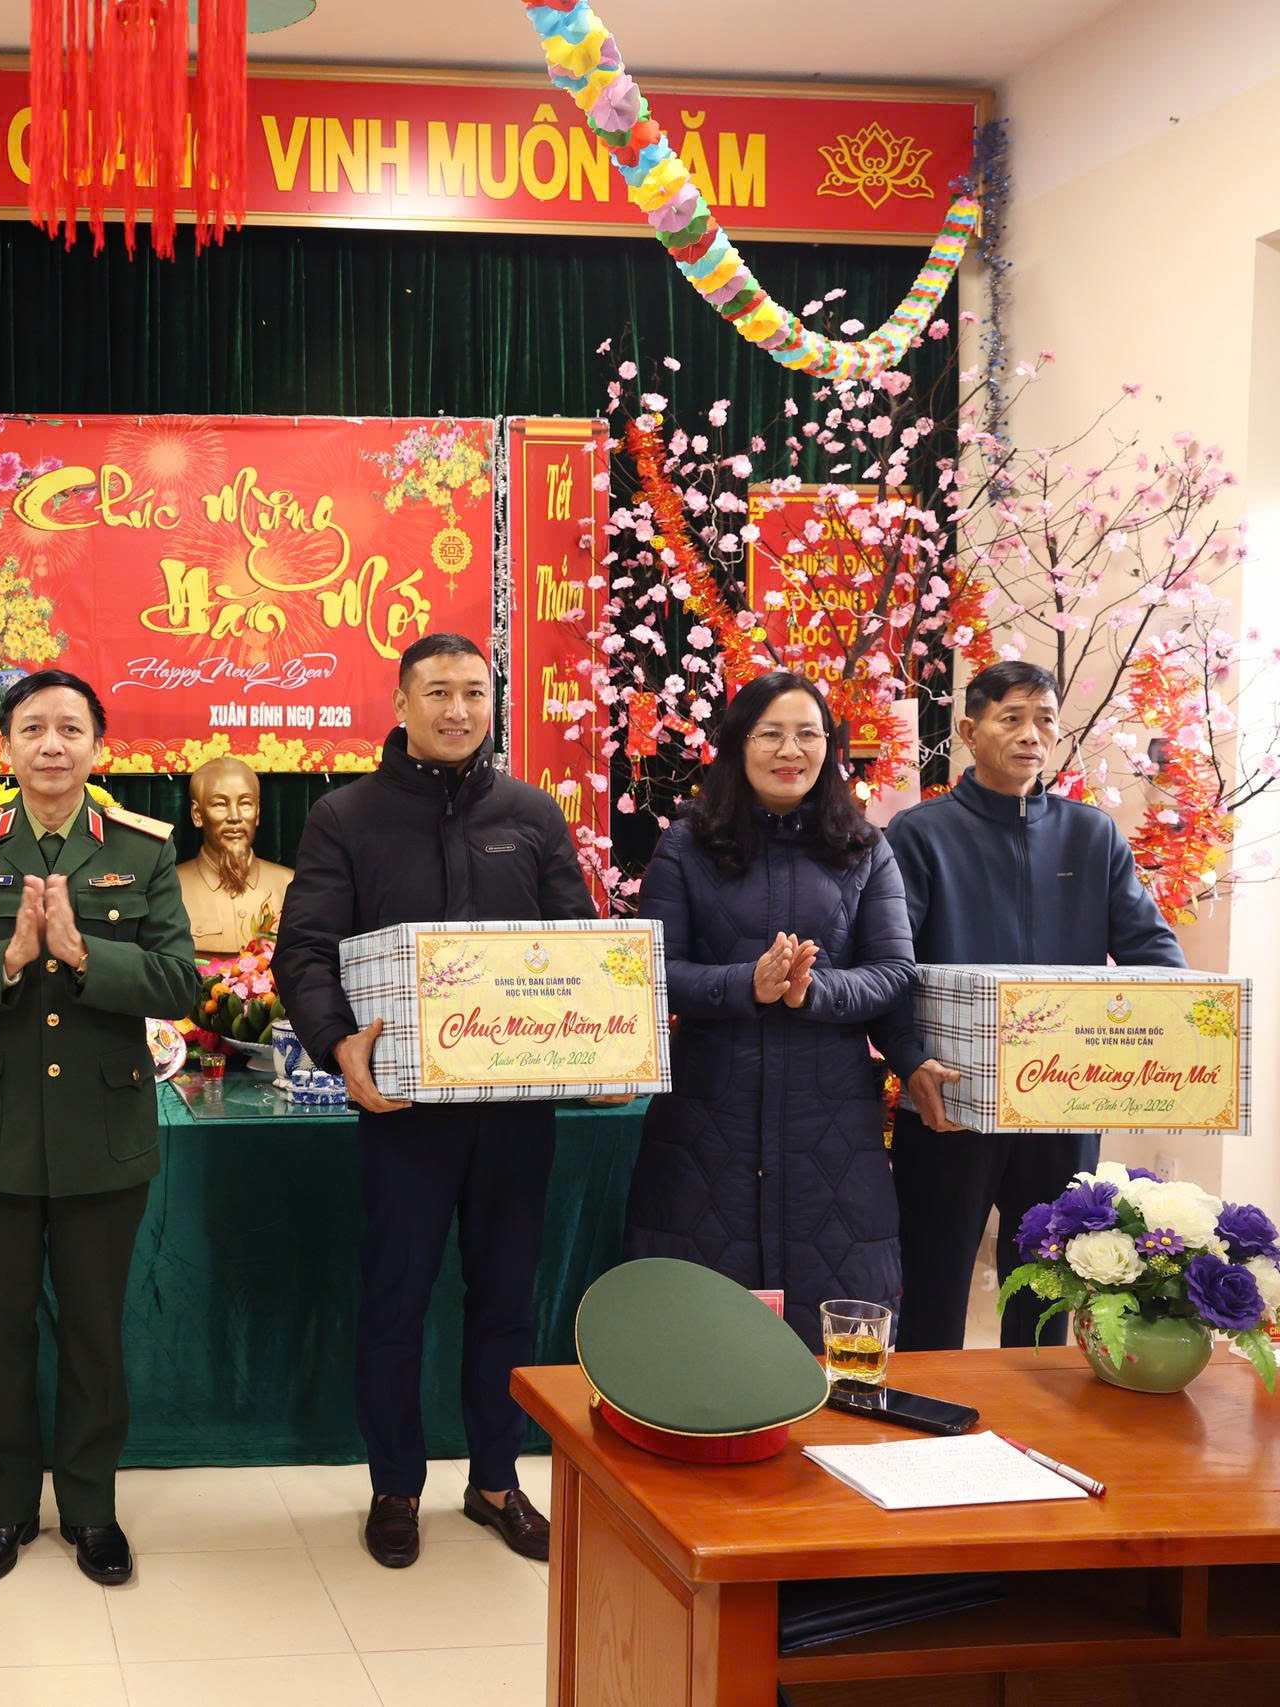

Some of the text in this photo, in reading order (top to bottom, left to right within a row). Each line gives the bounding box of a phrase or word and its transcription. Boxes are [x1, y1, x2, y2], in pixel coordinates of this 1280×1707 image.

[261, 115, 410, 196] VINH
[426, 112, 610, 203] MUÔN
[628, 110, 767, 207] ĂM
[13, 464, 182, 531] Chúc
[546, 453, 574, 520] Tết
[140, 555, 432, 659] Năm Mới
[789, 625, 831, 653] HỌC
[111, 656, 215, 694] Happy
[243, 653, 338, 694] Year
[209, 701, 352, 730] XUÂN BÍNH NGỌ 2026
[438, 1006, 639, 1049] Chúc Mừng Năm Mới
[1109, 1027, 1125, 1035] BAN
[1016, 1053, 1222, 1093] Chúc Mừng Năm Mới
[1143, 1098, 1175, 1113] 2026
